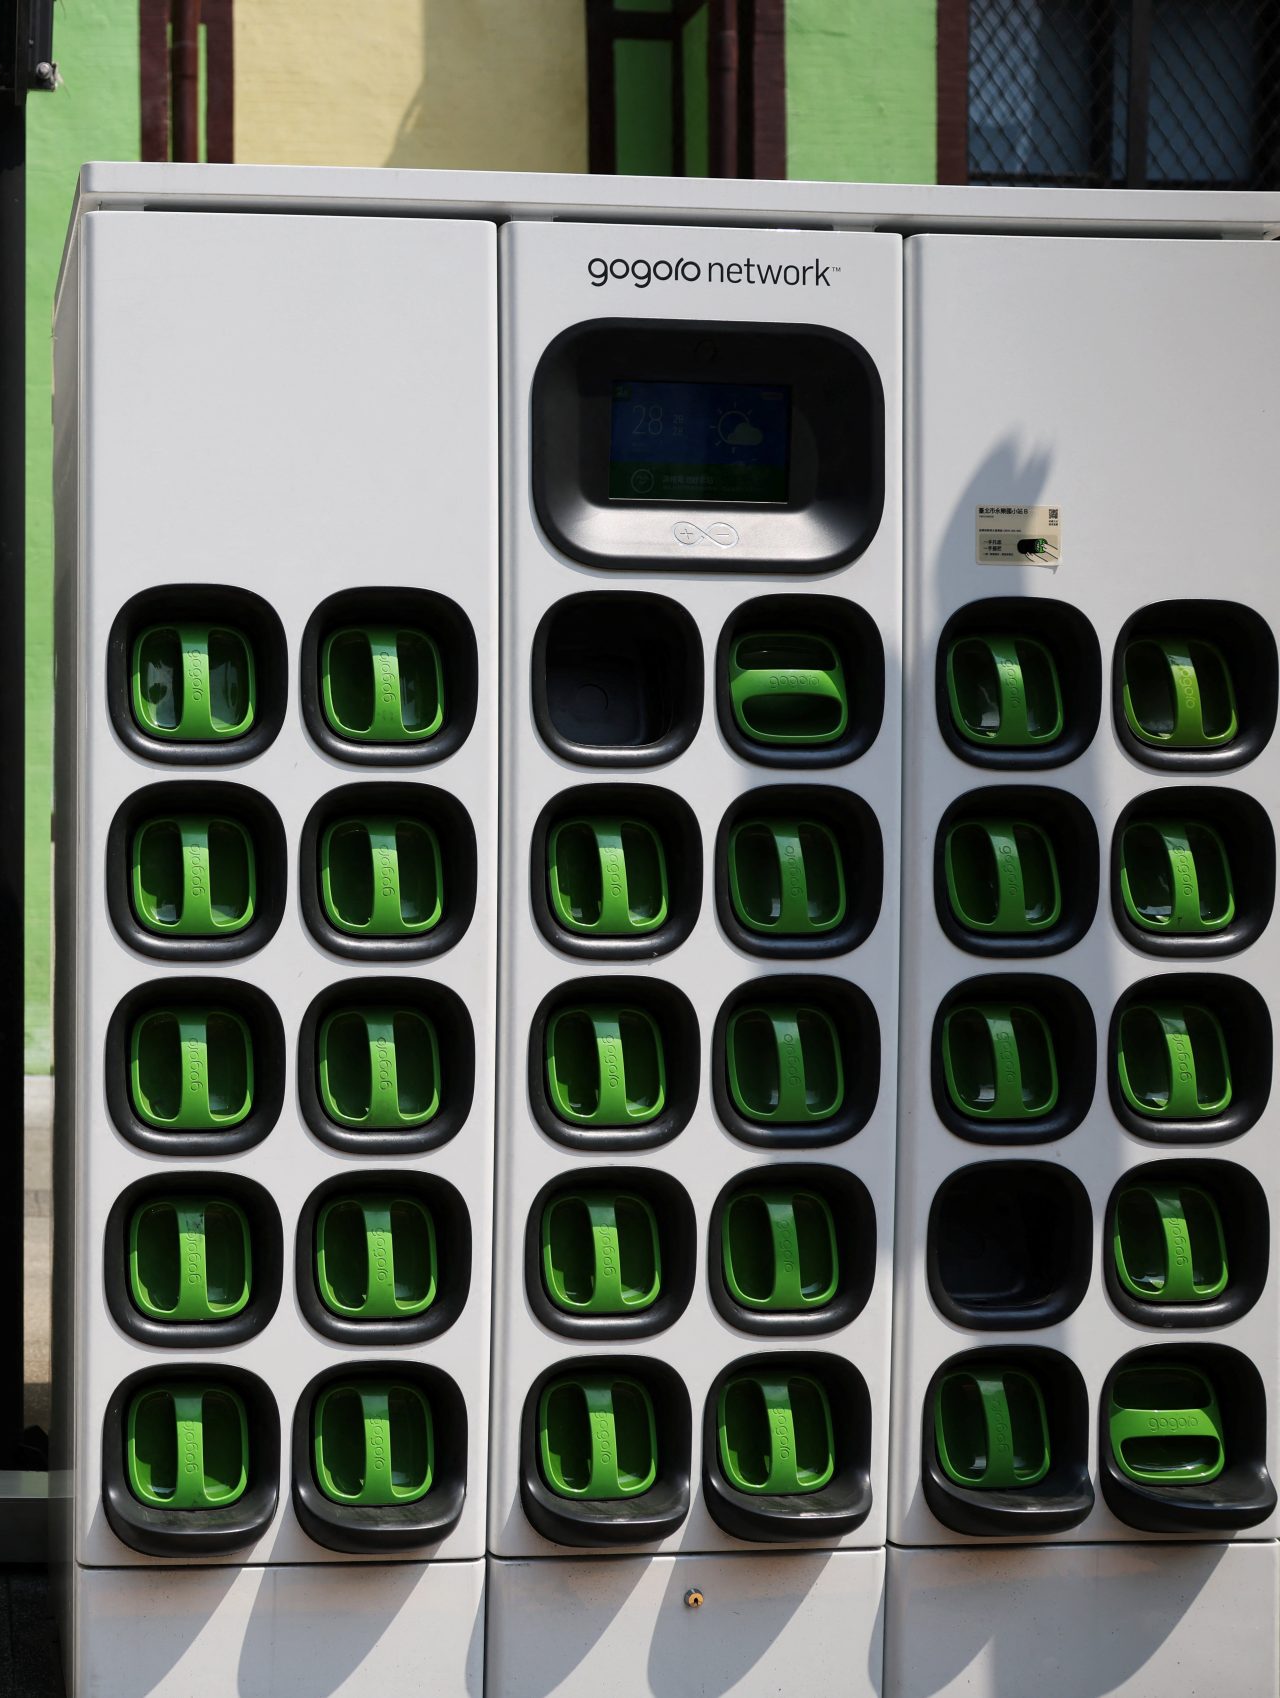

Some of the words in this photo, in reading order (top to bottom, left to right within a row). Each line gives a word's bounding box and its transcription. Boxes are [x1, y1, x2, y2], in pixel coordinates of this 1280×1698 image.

[588, 257, 701, 289] gogoro
[632, 403, 663, 436] 28
[188, 649, 202, 701] gogoro
[379, 650, 395, 702] gogoro
[769, 674, 819, 688] gogoro
[188, 844, 205, 896] gogoro
[379, 844, 395, 896] gogoro
[605, 844, 620, 897] gogoro
[785, 845, 803, 896] gogoro
[1000, 845, 1017, 896] gogoro
[1173, 845, 1192, 896] gogoro
[190, 1037, 203, 1092] gogoro
[377, 1037, 392, 1090] gogoro
[602, 1035, 618, 1088] gogoro
[784, 1033, 800, 1087] gogoro
[186, 1229, 200, 1284] gogoro
[372, 1227, 387, 1281] gogoro
[601, 1223, 616, 1277] gogoro
[1168, 1217, 1188, 1266] gogoro
[182, 1420, 198, 1473] gogoro
[1149, 1416, 1199, 1431] gogoro
